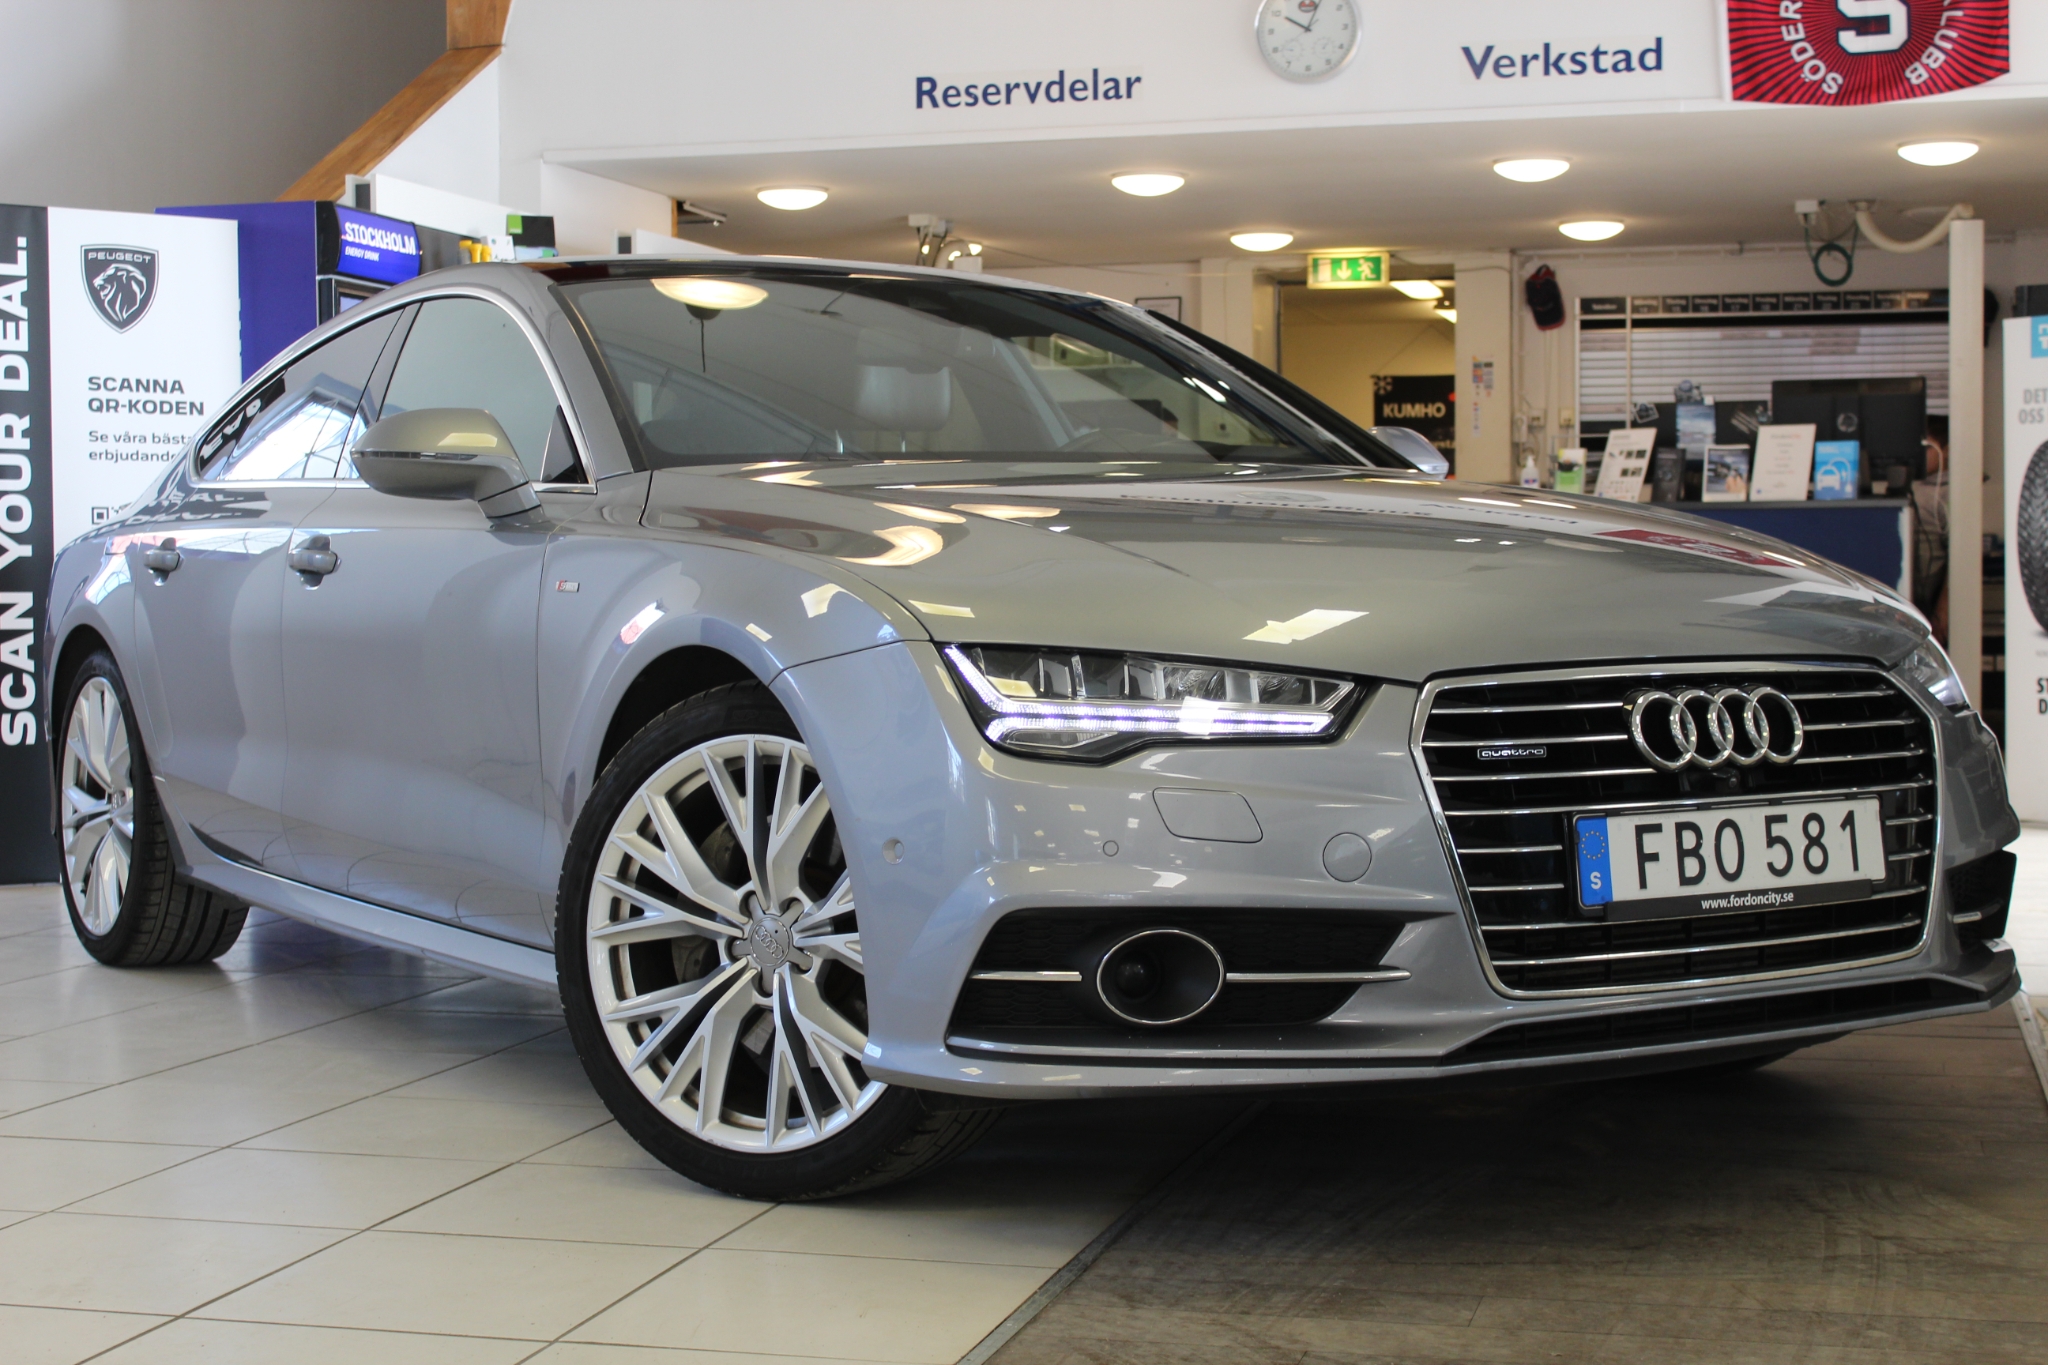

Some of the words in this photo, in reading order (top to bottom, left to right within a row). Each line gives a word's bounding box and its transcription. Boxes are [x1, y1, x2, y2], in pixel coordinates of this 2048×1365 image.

[1904, 0, 1964, 85] LUBB
[1460, 36, 1663, 80] Verkstad
[915, 68, 1142, 109] Reservdelar
[344, 221, 417, 256] STOCKHOLM
[88, 251, 152, 264] PEUGEOT
[344, 246, 365, 259] ENERGY
[364, 249, 380, 262] DRINK
[0, 236, 29, 392] DEAL.
[88, 376, 185, 395] SCANNA
[87, 397, 205, 416] QR-KODEN
[1382, 402, 1446, 418] KUMHO
[2018, 408, 2045, 425] OSS
[88, 430, 109, 443] Se
[113, 431, 147, 444] våra
[0, 414, 33, 571] YOUR
[0, 591, 37, 747] SCAN
[1481, 748, 1544, 758] quattro
[1634, 817, 1746, 890] FBO
[1764, 809, 1860, 879] 581
[1589, 870, 1602, 891] S
[1701, 891, 1795, 910] www.fordoncity.se
